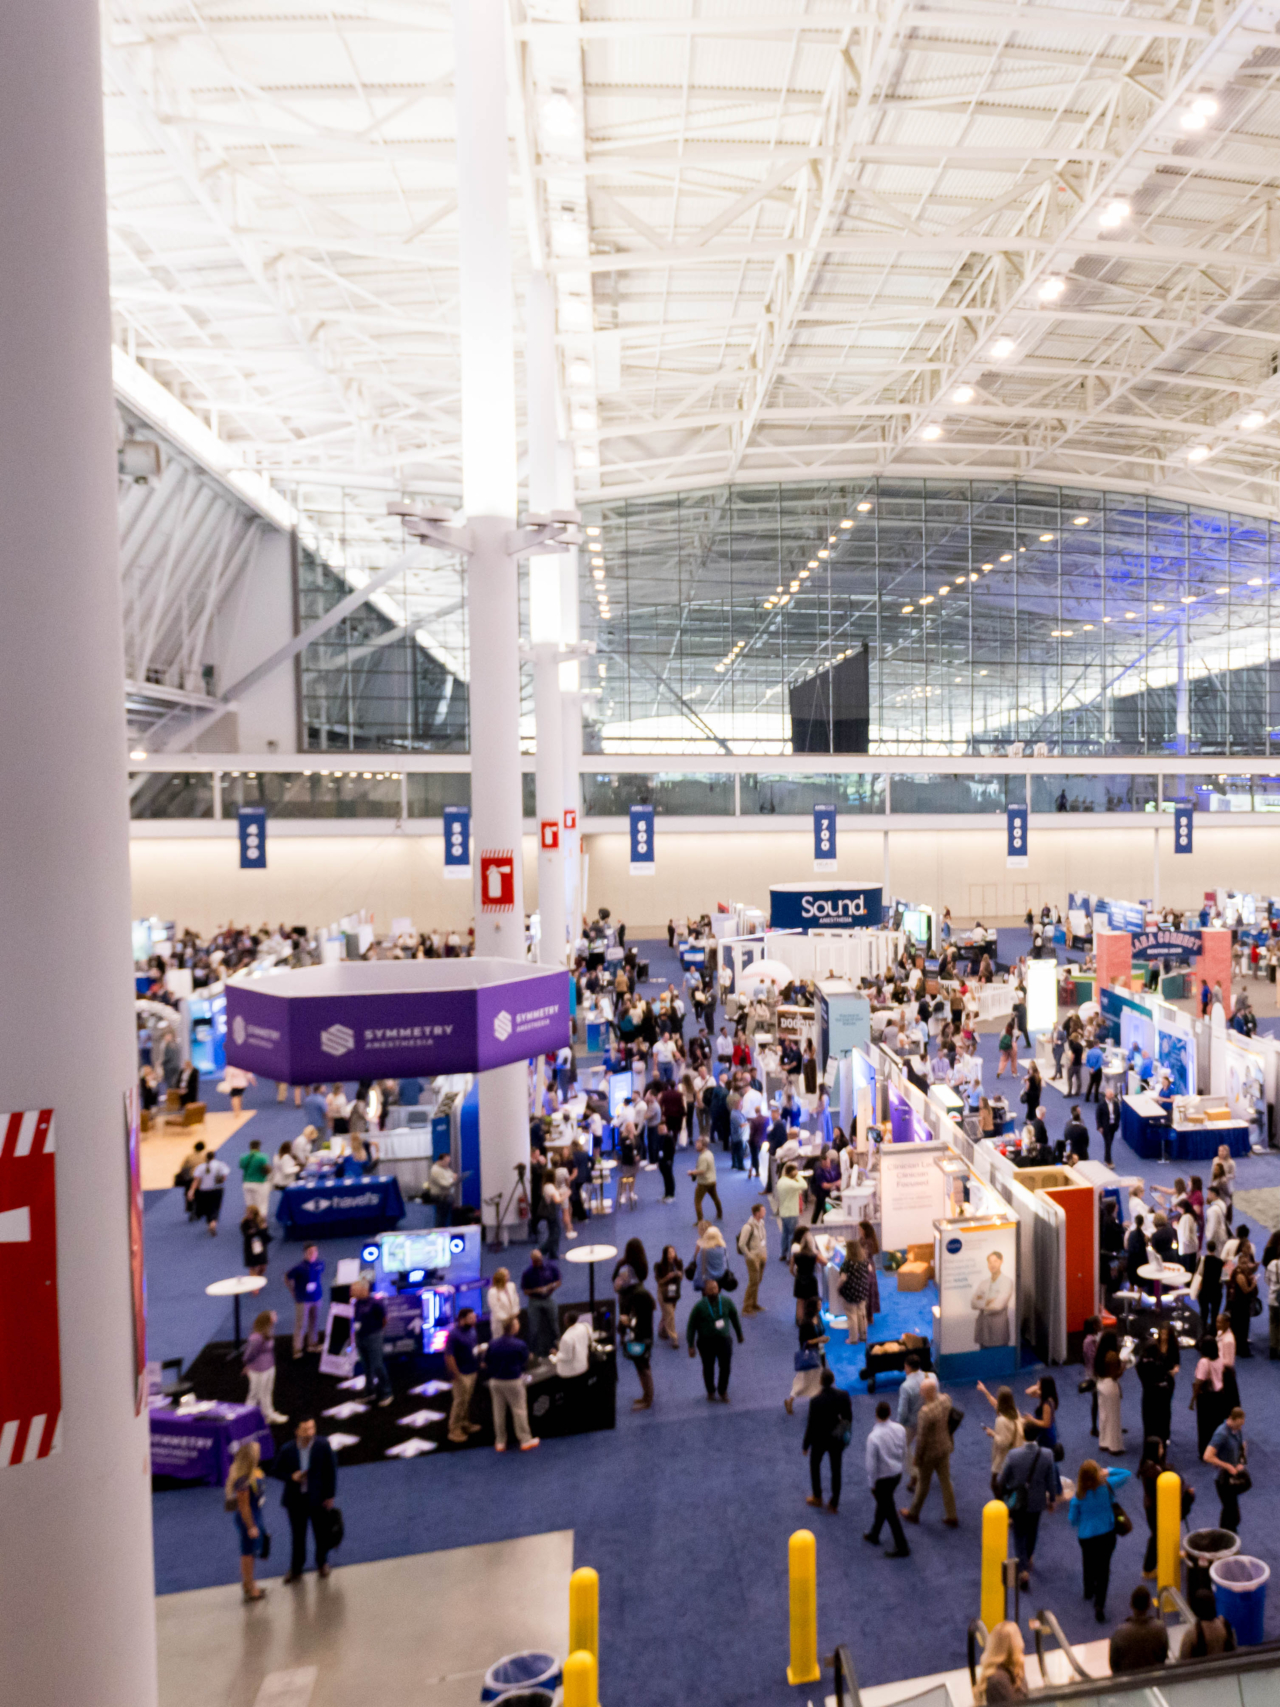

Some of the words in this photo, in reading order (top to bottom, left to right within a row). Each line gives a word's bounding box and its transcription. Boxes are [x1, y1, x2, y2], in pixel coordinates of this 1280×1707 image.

[246, 823, 259, 859] 400
[637, 821, 647, 853] 600
[821, 819, 830, 851] 700
[801, 894, 867, 918] Sound.
[515, 1004, 560, 1024] SYMMETRY
[364, 1024, 454, 1040] SYMMETRY
[365, 1038, 434, 1049] ANESTHESIA
